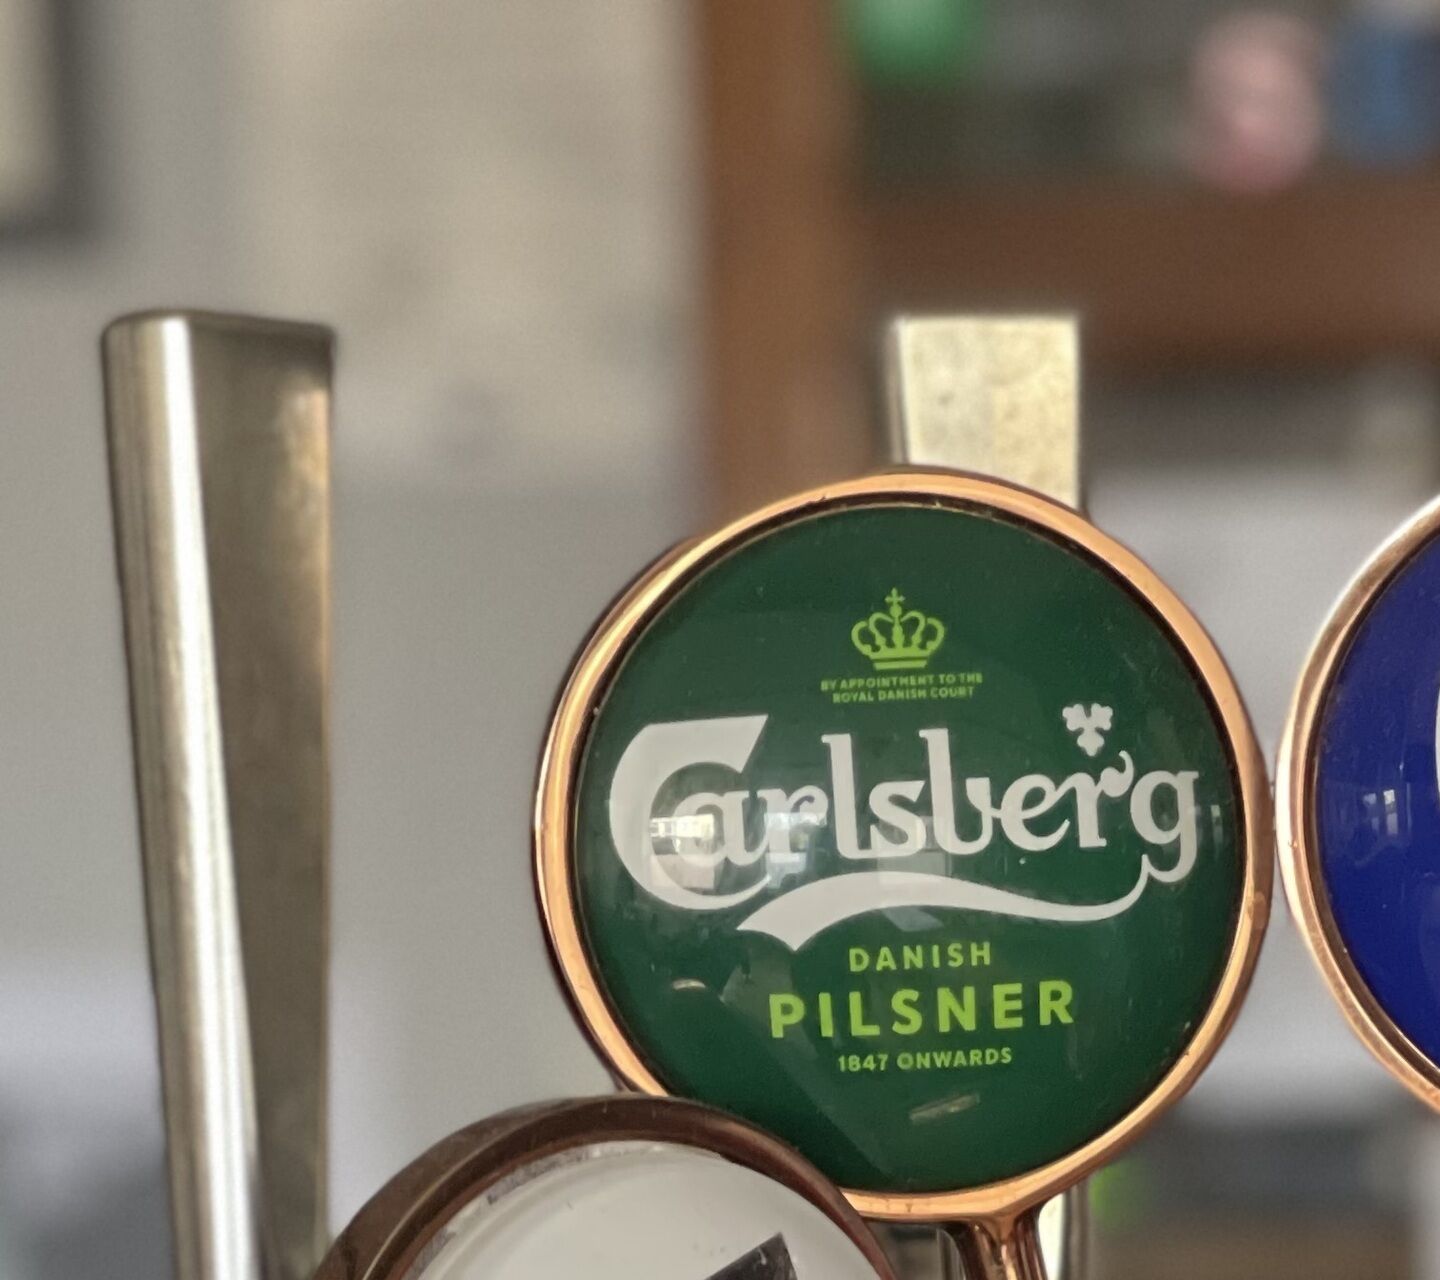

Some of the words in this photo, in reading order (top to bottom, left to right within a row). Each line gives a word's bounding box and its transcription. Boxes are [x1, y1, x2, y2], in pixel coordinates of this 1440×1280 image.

[820, 680, 837, 691] BY
[840, 675, 934, 690] APPOINTMENT
[939, 673, 956, 684] TO
[960, 672, 983, 684] THE
[832, 692, 874, 704] ROYAL
[878, 688, 927, 701] DANISH
[930, 686, 974, 699] COURT
[609, 712, 1200, 950] Carlsberg
[849, 941, 991, 972] DANISH
[768, 980, 1074, 1038] PILSNER
[838, 1053, 888, 1073] 1847
[896, 1047, 1013, 1071] ONWARDS
